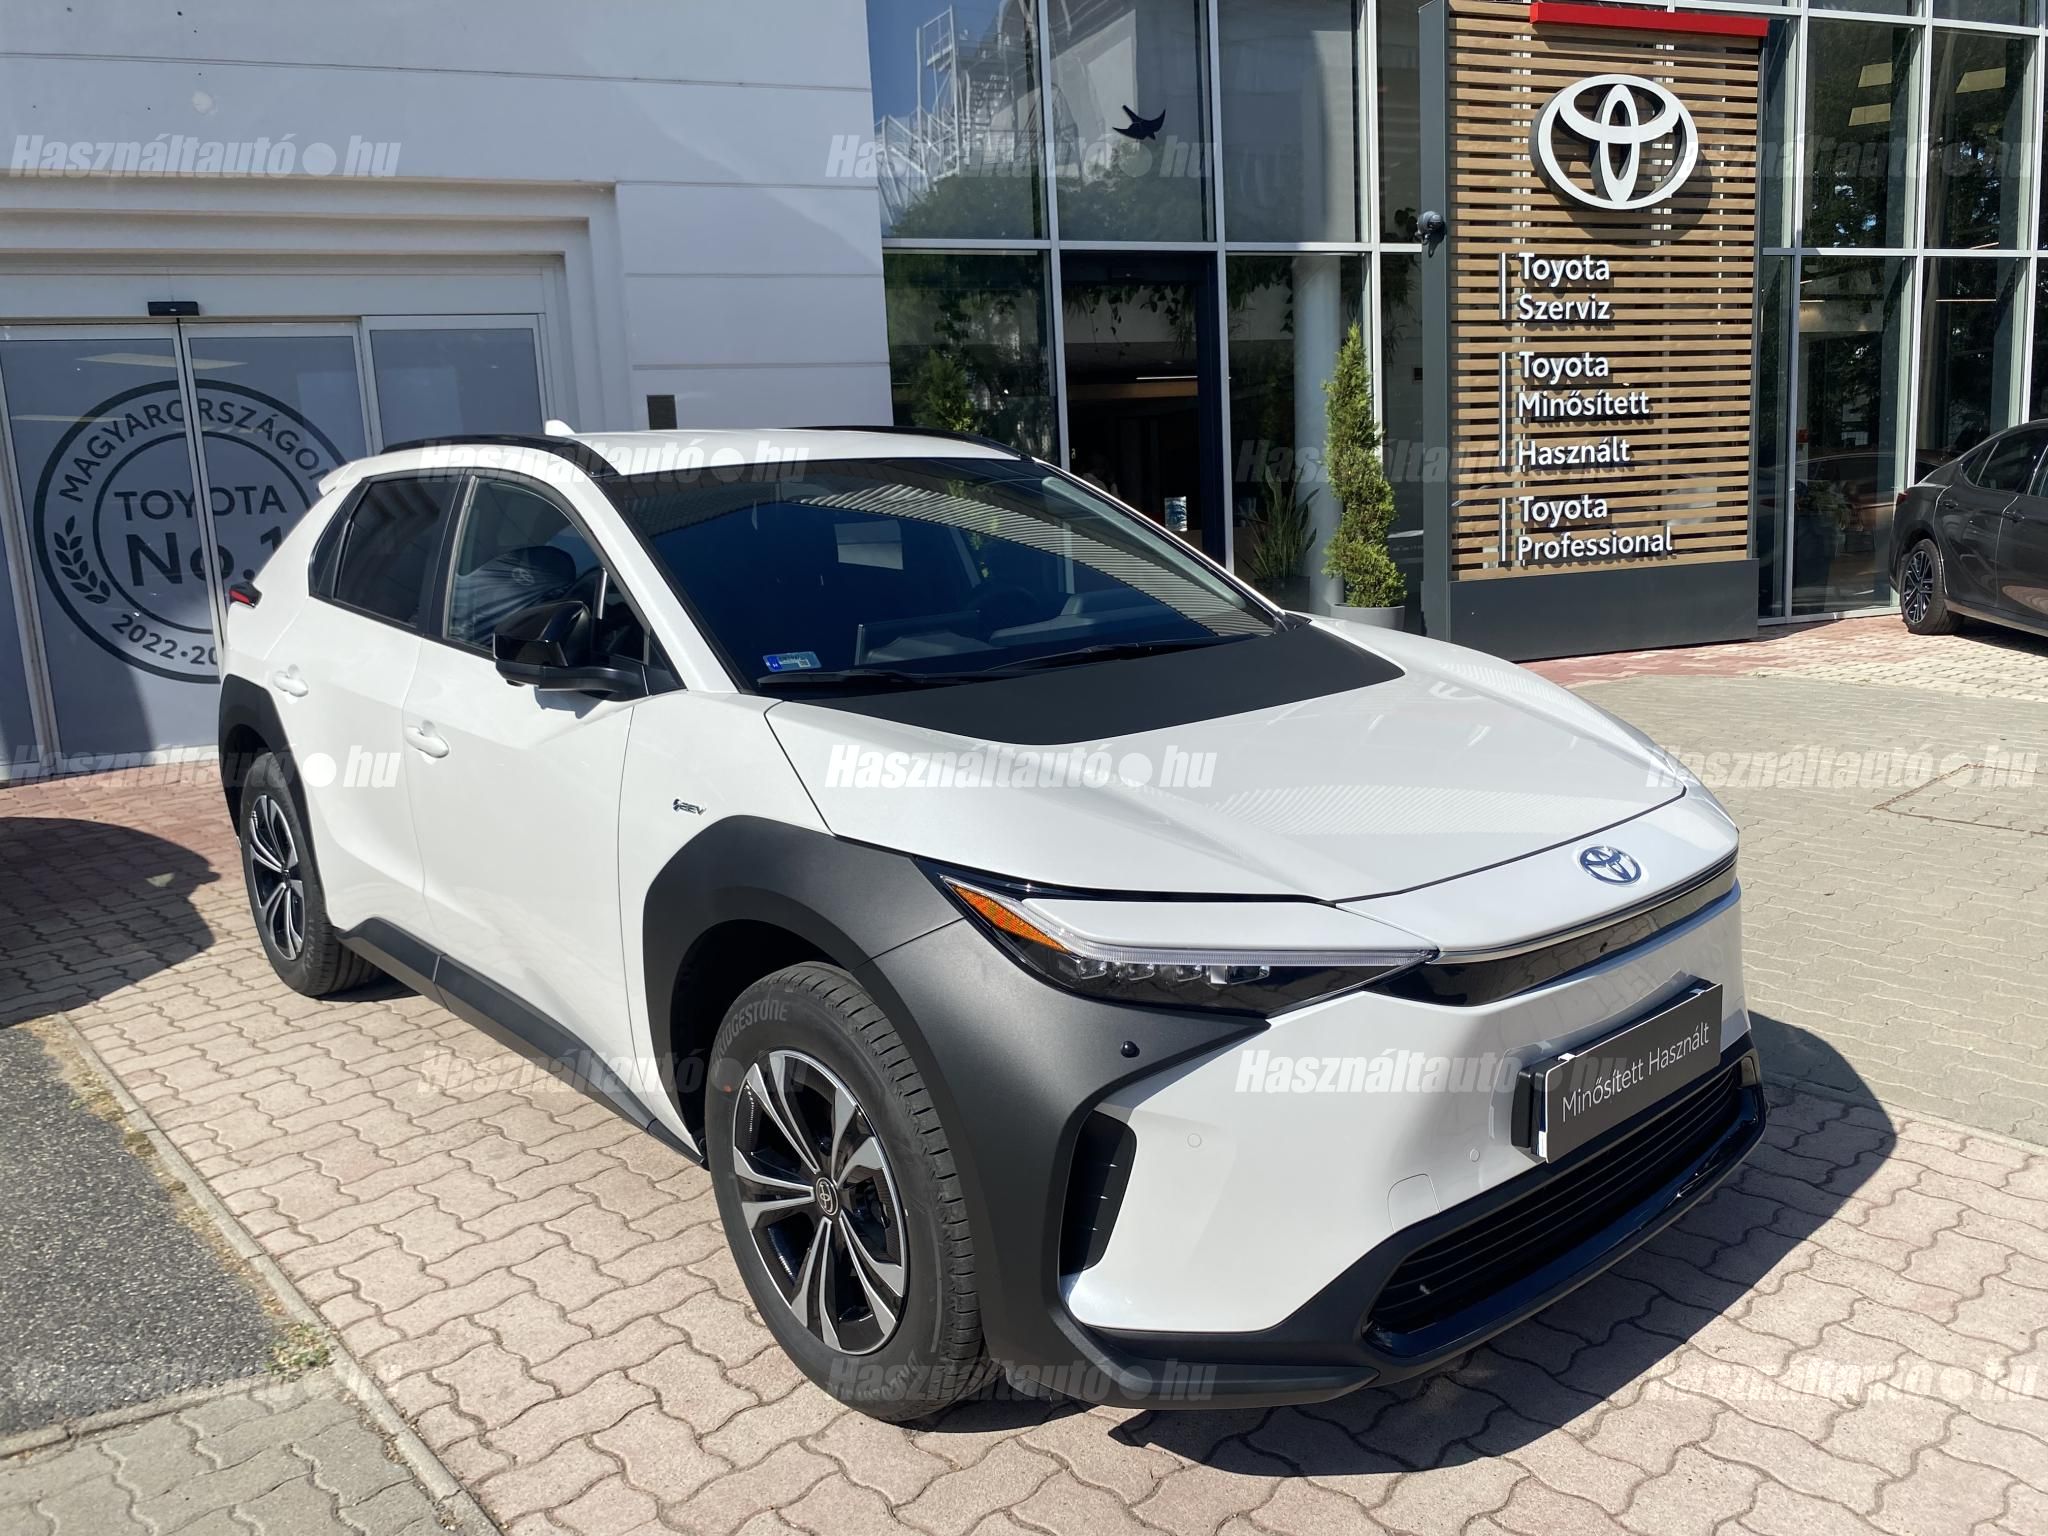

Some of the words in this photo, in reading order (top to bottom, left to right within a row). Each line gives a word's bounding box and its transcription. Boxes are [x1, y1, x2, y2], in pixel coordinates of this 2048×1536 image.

[1519, 252, 1610, 287] Toyota
[1519, 293, 1610, 320] Szerviz
[1519, 351, 1609, 385] Toyota
[1518, 389, 1650, 417] Minősített
[1518, 436, 1630, 465] Használt
[114, 485, 287, 521] TOYOTA
[1518, 494, 1608, 527] Toyota
[1518, 526, 1672, 560] Professional
[711, 999, 790, 1064] RIDGESTONE
[1562, 1059, 1644, 1122] Minősített
[1648, 1022, 1710, 1076] Használt
